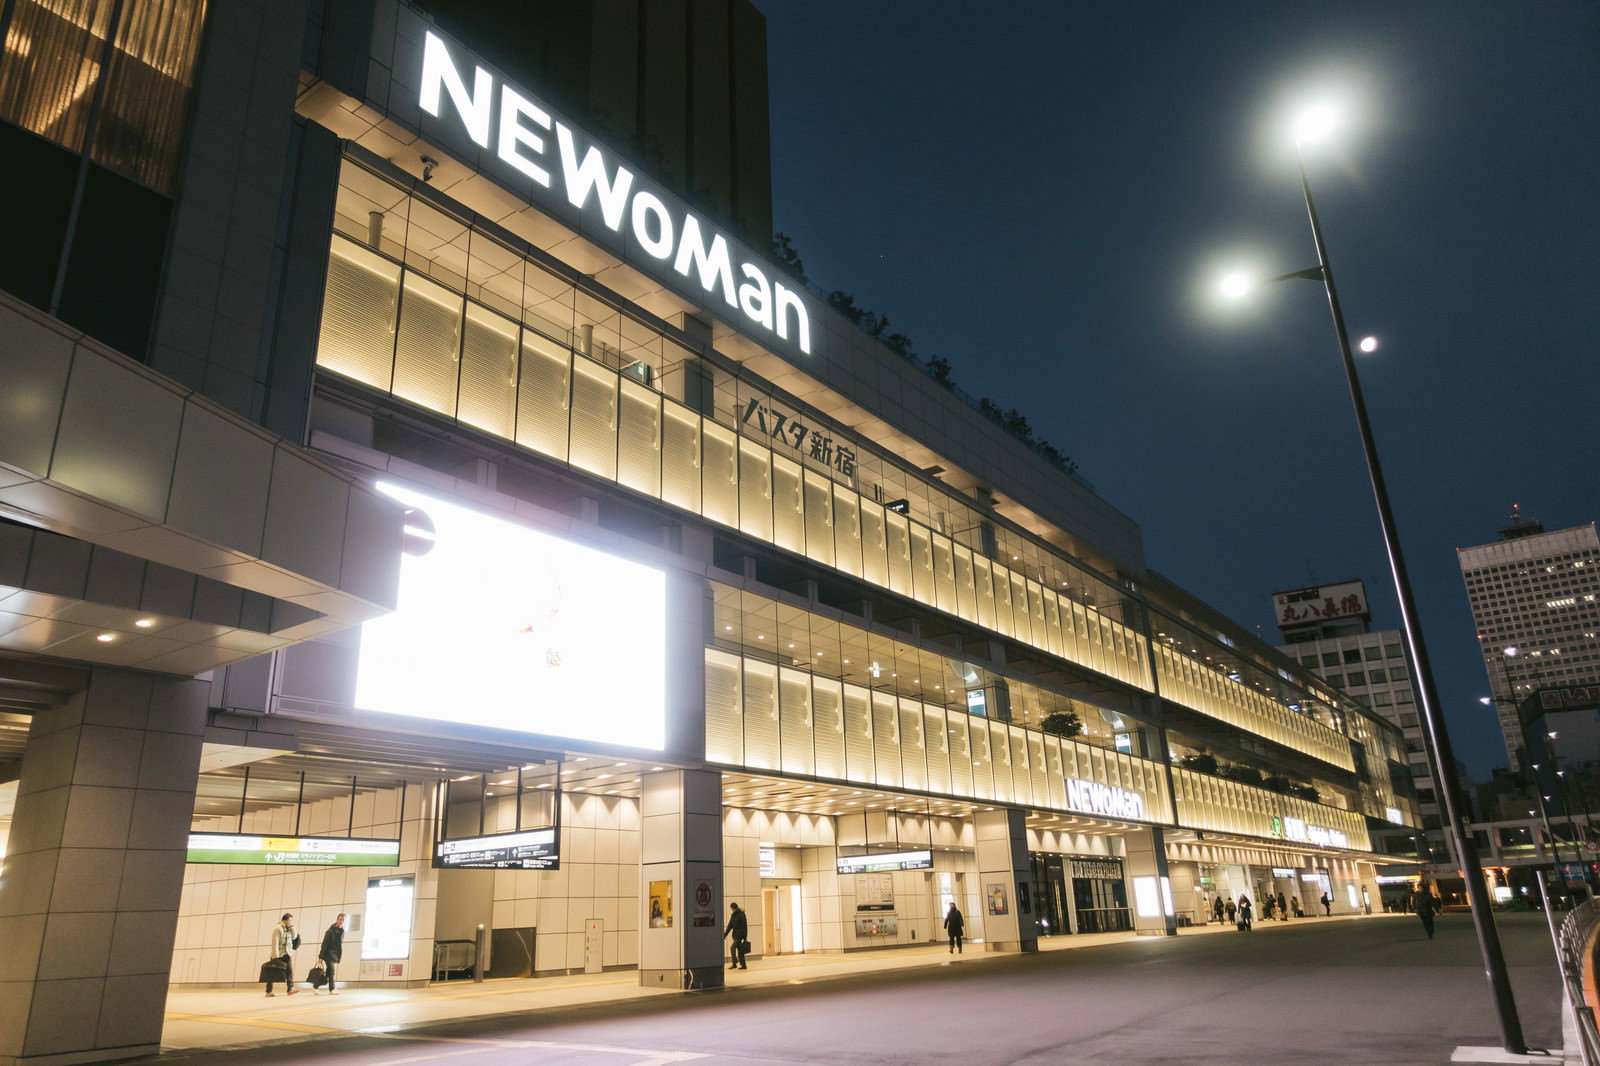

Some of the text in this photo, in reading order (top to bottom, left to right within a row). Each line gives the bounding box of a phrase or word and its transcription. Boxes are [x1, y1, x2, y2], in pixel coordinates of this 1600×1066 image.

[419, 30, 812, 355] NEWoMan
[742, 397, 857, 478] バスタ新宿
